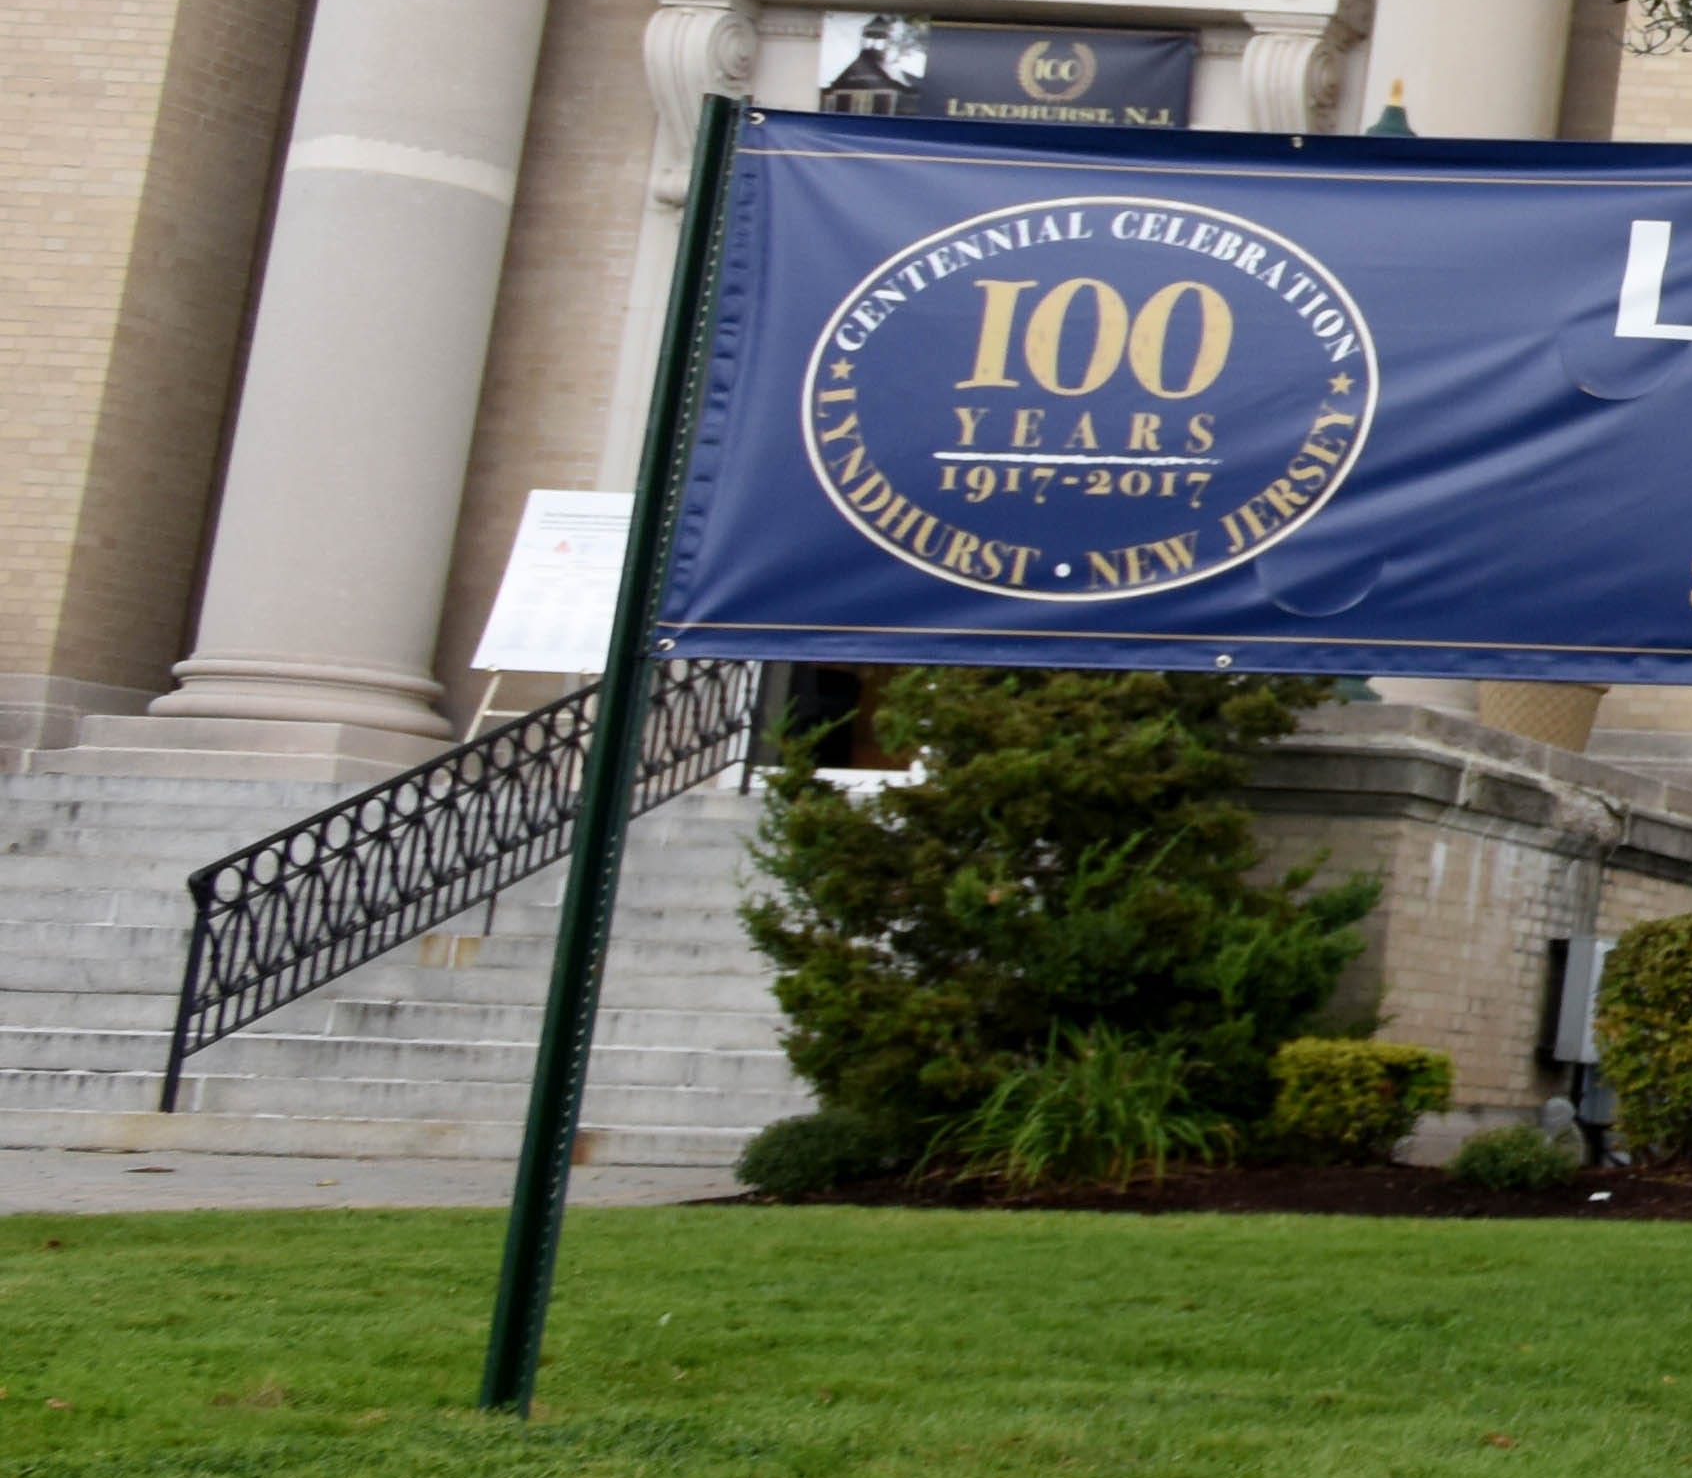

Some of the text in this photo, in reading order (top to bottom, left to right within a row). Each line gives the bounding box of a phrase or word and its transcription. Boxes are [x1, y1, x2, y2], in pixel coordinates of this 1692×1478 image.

[834, 209, 1361, 365] CENTENNIAL CELEBRATION
[953, 277, 1235, 401] 100
[817, 387, 1359, 591] LYNDHURST NEW JERSEY
[938, 465, 1213, 509] 1917-2017
[953, 407, 1217, 456] YEARS
